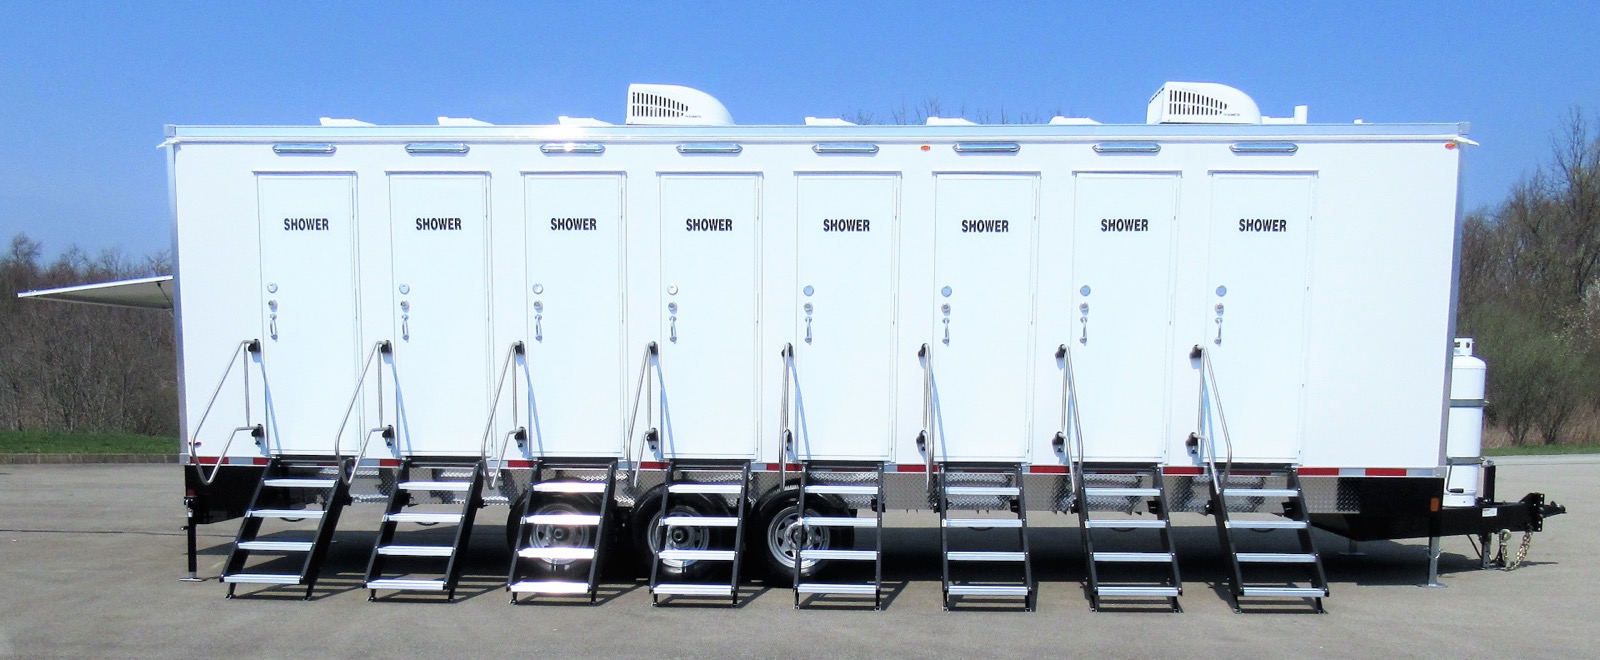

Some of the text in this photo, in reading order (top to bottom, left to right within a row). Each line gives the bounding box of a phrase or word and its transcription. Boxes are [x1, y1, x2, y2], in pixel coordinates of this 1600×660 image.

[284, 218, 329, 231] SHOWER
[416, 218, 462, 231] SHOWER
[550, 218, 597, 231] SHOWER
[685, 218, 733, 232] SHOWER
[823, 218, 870, 232] SHOWER
[961, 219, 1009, 233] SHOWER
[1101, 218, 1149, 232] SHOWER
[1238, 218, 1287, 232] SHOWER
